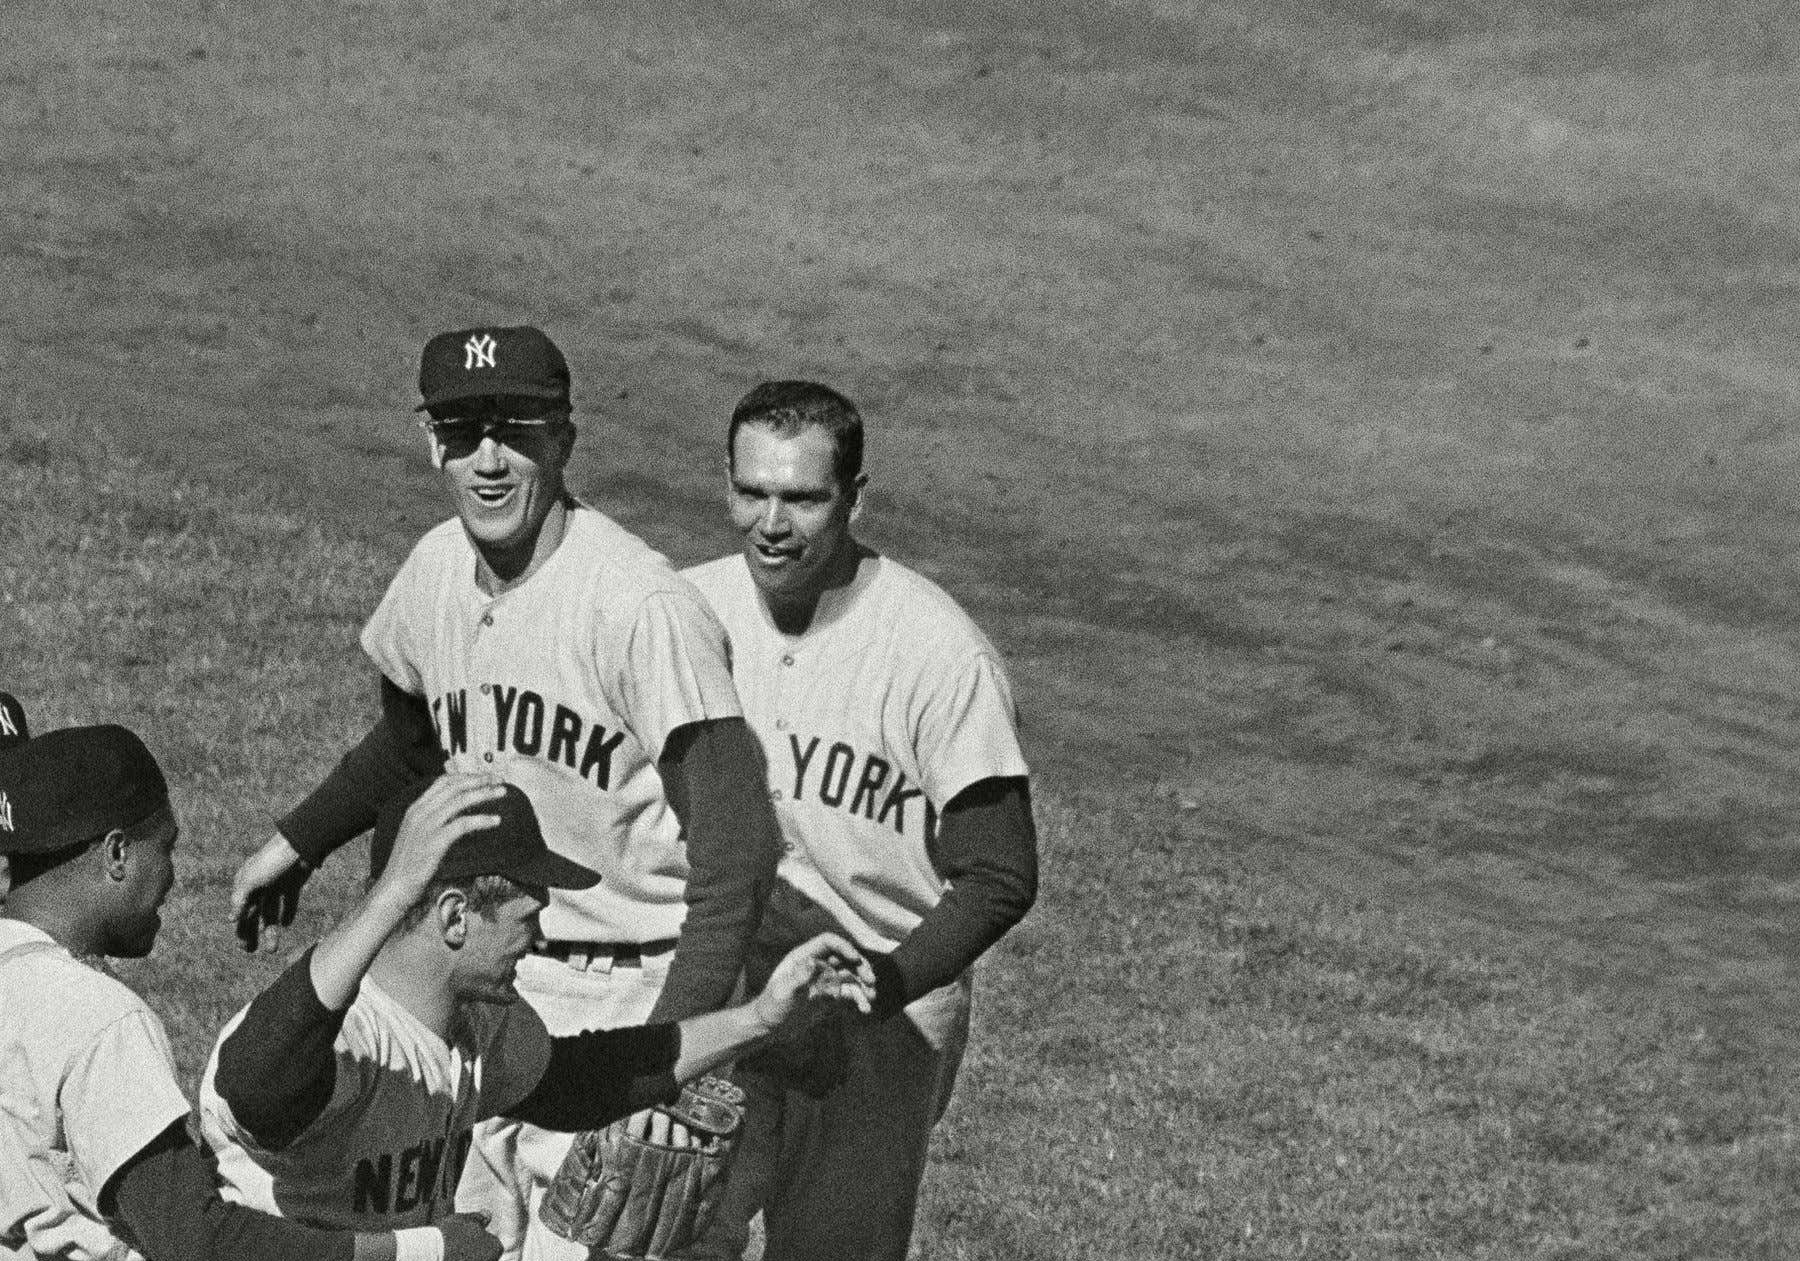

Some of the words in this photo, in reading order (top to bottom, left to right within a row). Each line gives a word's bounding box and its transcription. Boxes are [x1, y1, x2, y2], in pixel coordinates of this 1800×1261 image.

[464, 333, 497, 370] NY
[492, 684, 625, 792] YORK
[789, 733, 923, 835] YORK
[353, 1137, 445, 1214] NEW
